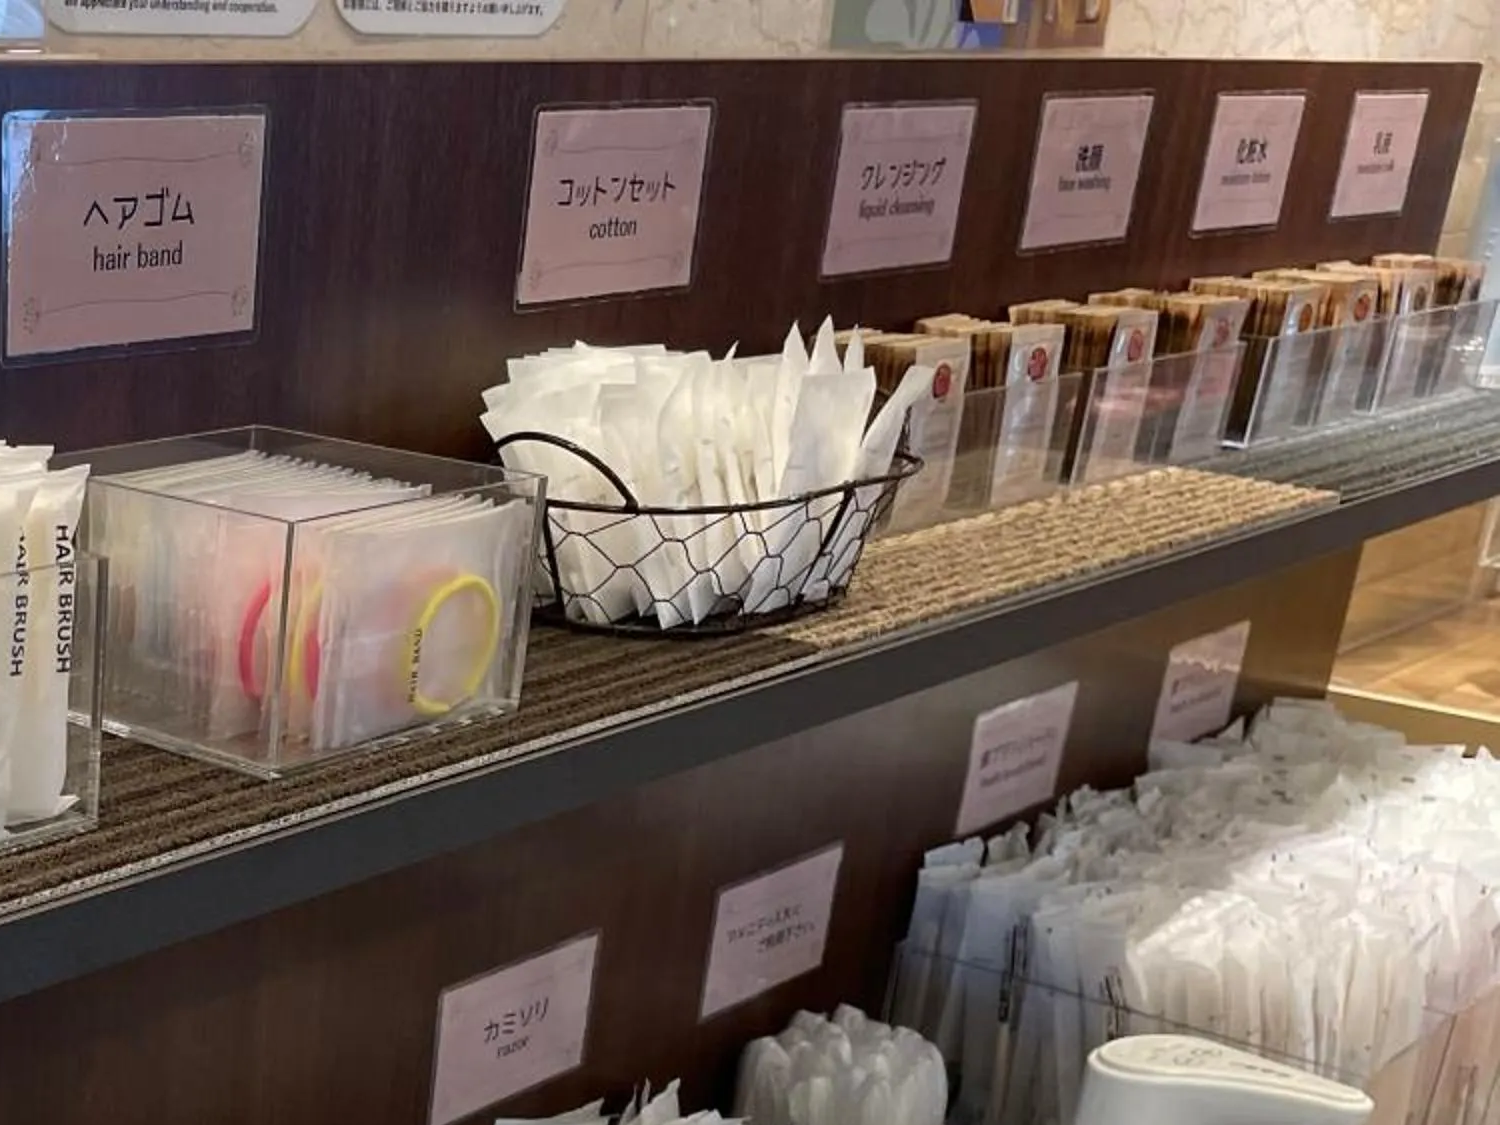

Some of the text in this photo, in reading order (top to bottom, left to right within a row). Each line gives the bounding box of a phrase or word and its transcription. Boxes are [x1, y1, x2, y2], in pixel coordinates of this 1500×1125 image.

[557, 171, 676, 207] コットンセット
[861, 156, 947, 190] クレンジング
[83, 187, 195, 230] ヘアゴム
[589, 217, 637, 240] cotton
[93, 240, 183, 272] hair band
[9, 526, 30, 677] AIR BRUSH
[55, 525, 74, 673] HAIR BRUSH
[484, 998, 549, 1044] カミソリ
[497, 1036, 530, 1058] razor
